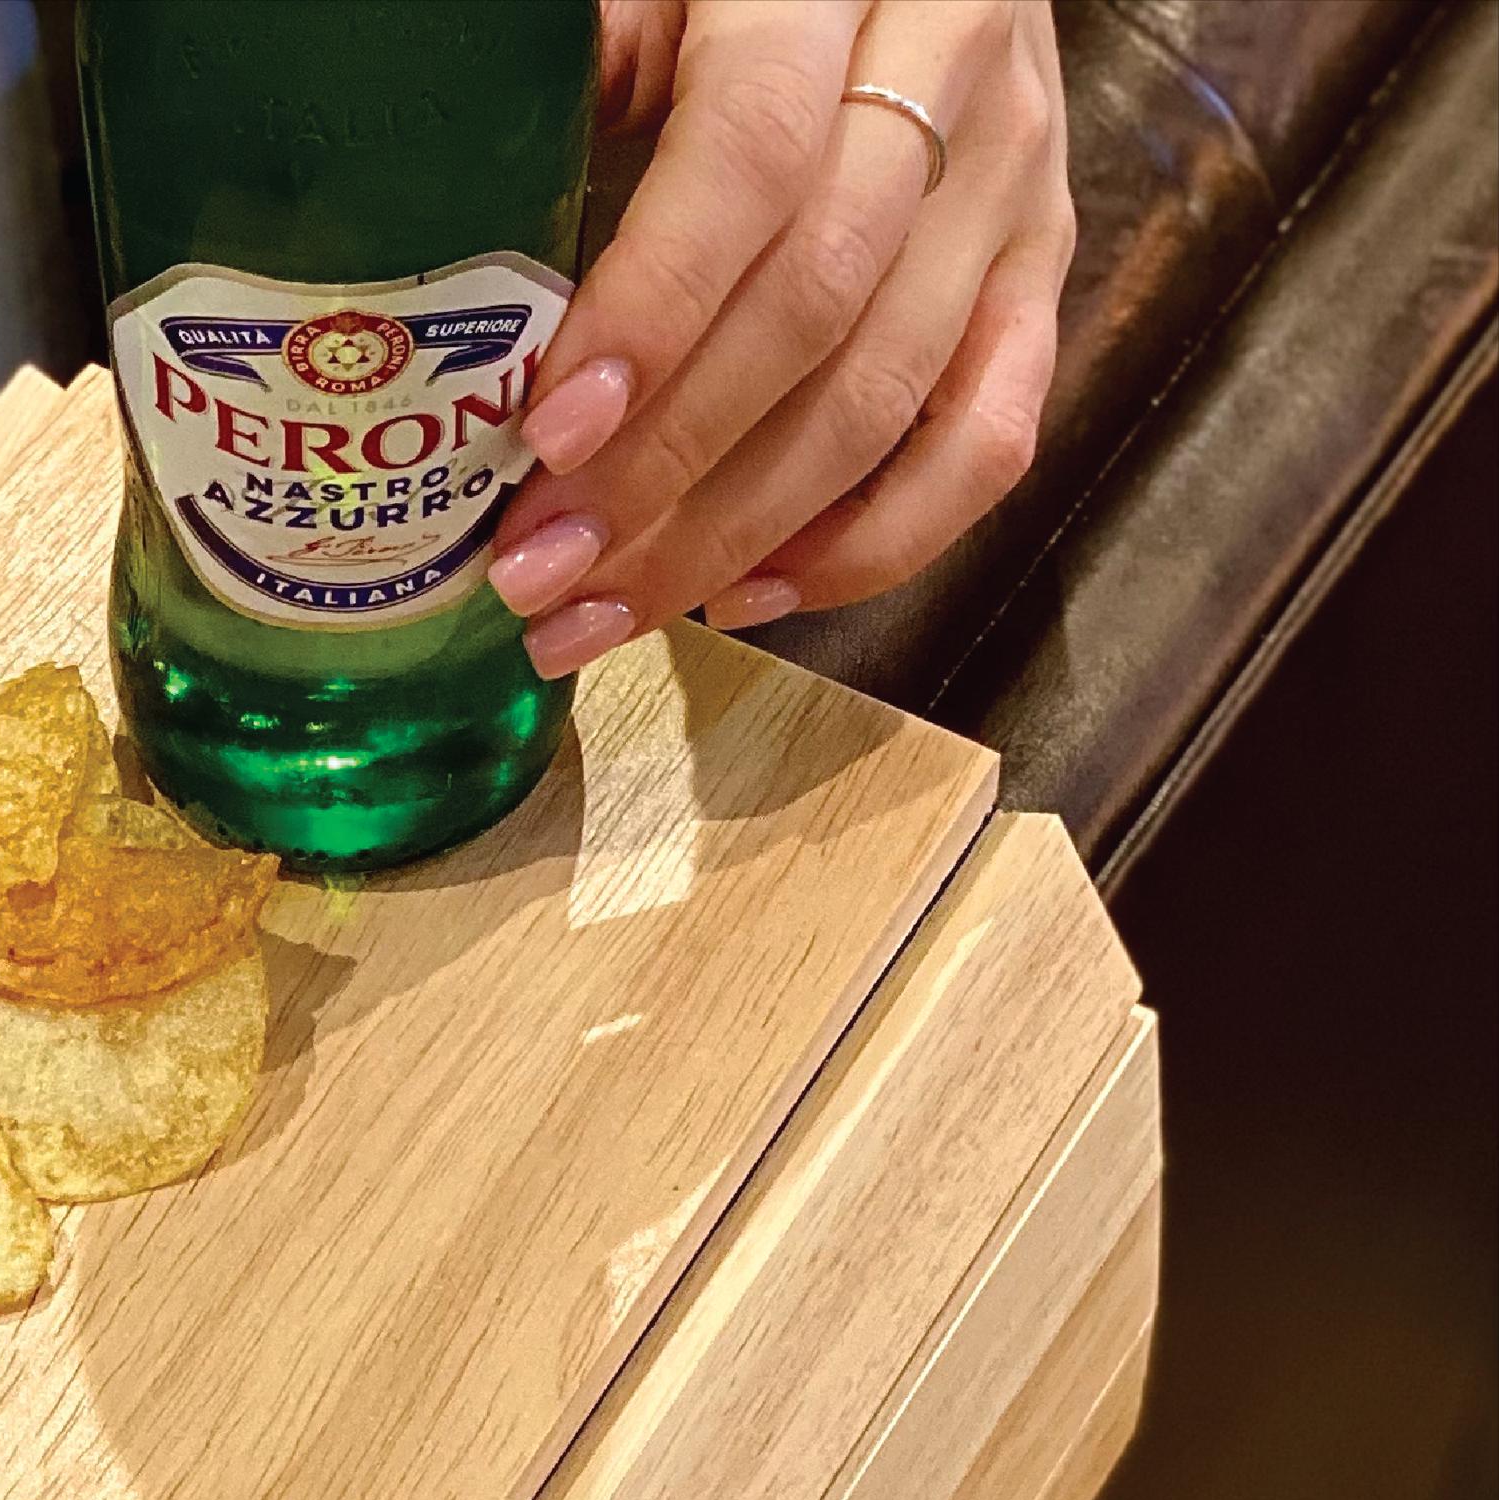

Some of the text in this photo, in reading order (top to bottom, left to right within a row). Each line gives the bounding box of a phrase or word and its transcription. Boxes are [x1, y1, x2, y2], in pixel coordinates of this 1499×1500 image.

[425, 318, 522, 338] SUPERIORE
[290, 322, 407, 373] BIRRA PERONI
[315, 376, 384, 394] ROMA
[286, 396, 413, 416] DAL 1846
[203, 466, 495, 532] AZZURRO
[245, 464, 451, 503] NASTRO
[256, 568, 442, 605] ITALIANA
